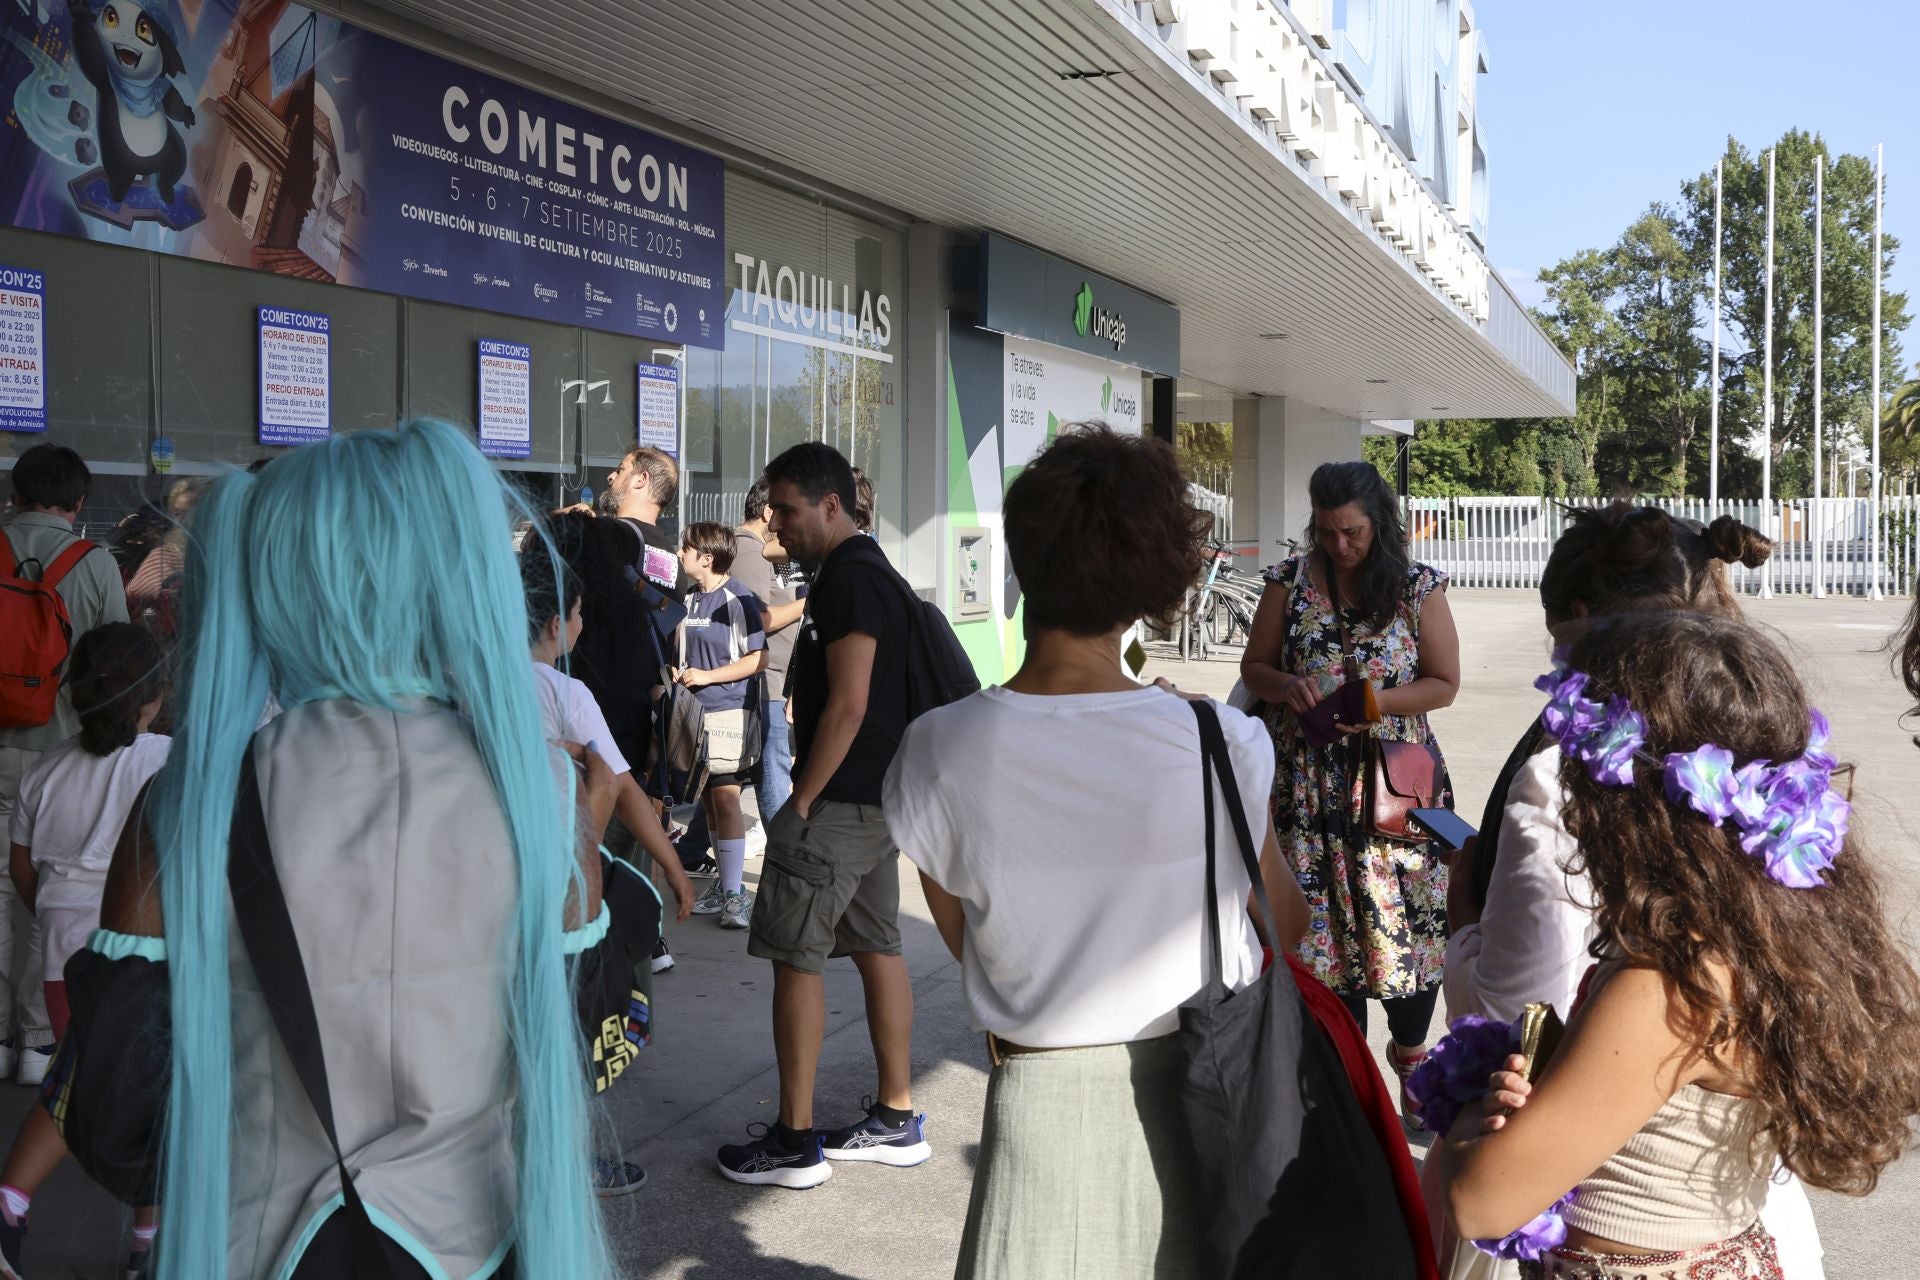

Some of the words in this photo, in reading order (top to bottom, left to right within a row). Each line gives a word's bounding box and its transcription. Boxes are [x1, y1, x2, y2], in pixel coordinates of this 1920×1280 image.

[442, 86, 688, 212] COMETCON
[392, 134, 459, 164] VIDEOXUEGOS
[464, 155, 519, 182] LLITERATURA
[525, 174, 543, 189] CINE
[548, 181, 581, 200] COSPLAY
[587, 191, 609, 208] CÓMIC
[633, 206, 675, 227] ILUSTRACIÓN
[678, 219, 691, 231] ROL
[694, 223, 716, 239] MÚSICA
[450, 176, 460, 201] 5
[486, 187, 497, 210] 6
[521, 196, 530, 218] 7
[540, 201, 639, 248] SETIEMBRE
[646, 231, 682, 259] 2025
[401, 203, 475, 233] CONVENCIÓN
[478, 222, 521, 244] XUVENIL
[524, 233, 537, 248] DE
[539, 237, 580, 258] CULTURA
[582, 247, 589, 260] Y
[591, 250, 612, 266] OCIU
[614, 257, 667, 279] ALTERNATIVU
[669, 269, 711, 290] D'ASTURIES
[0, 270, 42, 290] ON'25
[9, 294, 39, 309] VISITA
[734, 252, 891, 347] TAQUILLAS
[24, 310, 40, 320] 2025
[261, 308, 329, 331] COMETCON'25
[14, 322, 34, 332] 22:00
[1093, 306, 1126, 352] Unicaja
[14, 334, 34, 344] 22:00
[263, 329, 295, 342] HORARIO
[296, 333, 305, 343] DE
[306, 335, 327, 347] VISITA
[268, 341, 273, 349] 6
[11, 346, 15, 354] a
[17, 346, 37, 356] 20:00
[480, 341, 530, 358] COMETCON'25
[481, 359, 505, 369] HORARIO
[505, 361, 513, 370] DE
[1010, 352, 1019, 373] Te
[1019, 356, 1045, 380] atreves,
[14, 374, 32, 385] 8,50
[34, 375, 39, 386] €
[266, 383, 292, 395] PRECIO
[293, 386, 325, 398] ENTRADA
[1010, 382, 1016, 402] y
[1016, 378, 1022, 399] la
[1022, 382, 1036, 401] vida
[265, 395, 289, 406] Entrada
[1113, 391, 1136, 423] Unicaja
[0, 408, 44, 418] EVOLUCIONES
[483, 404, 503, 414] PRECIO
[503, 406, 527, 416] ENTRADA
[1010, 407, 1019, 424] se
[1019, 406, 1035, 426] abre
[8, 419, 17, 427] de
[17, 419, 45, 428] Admisión
